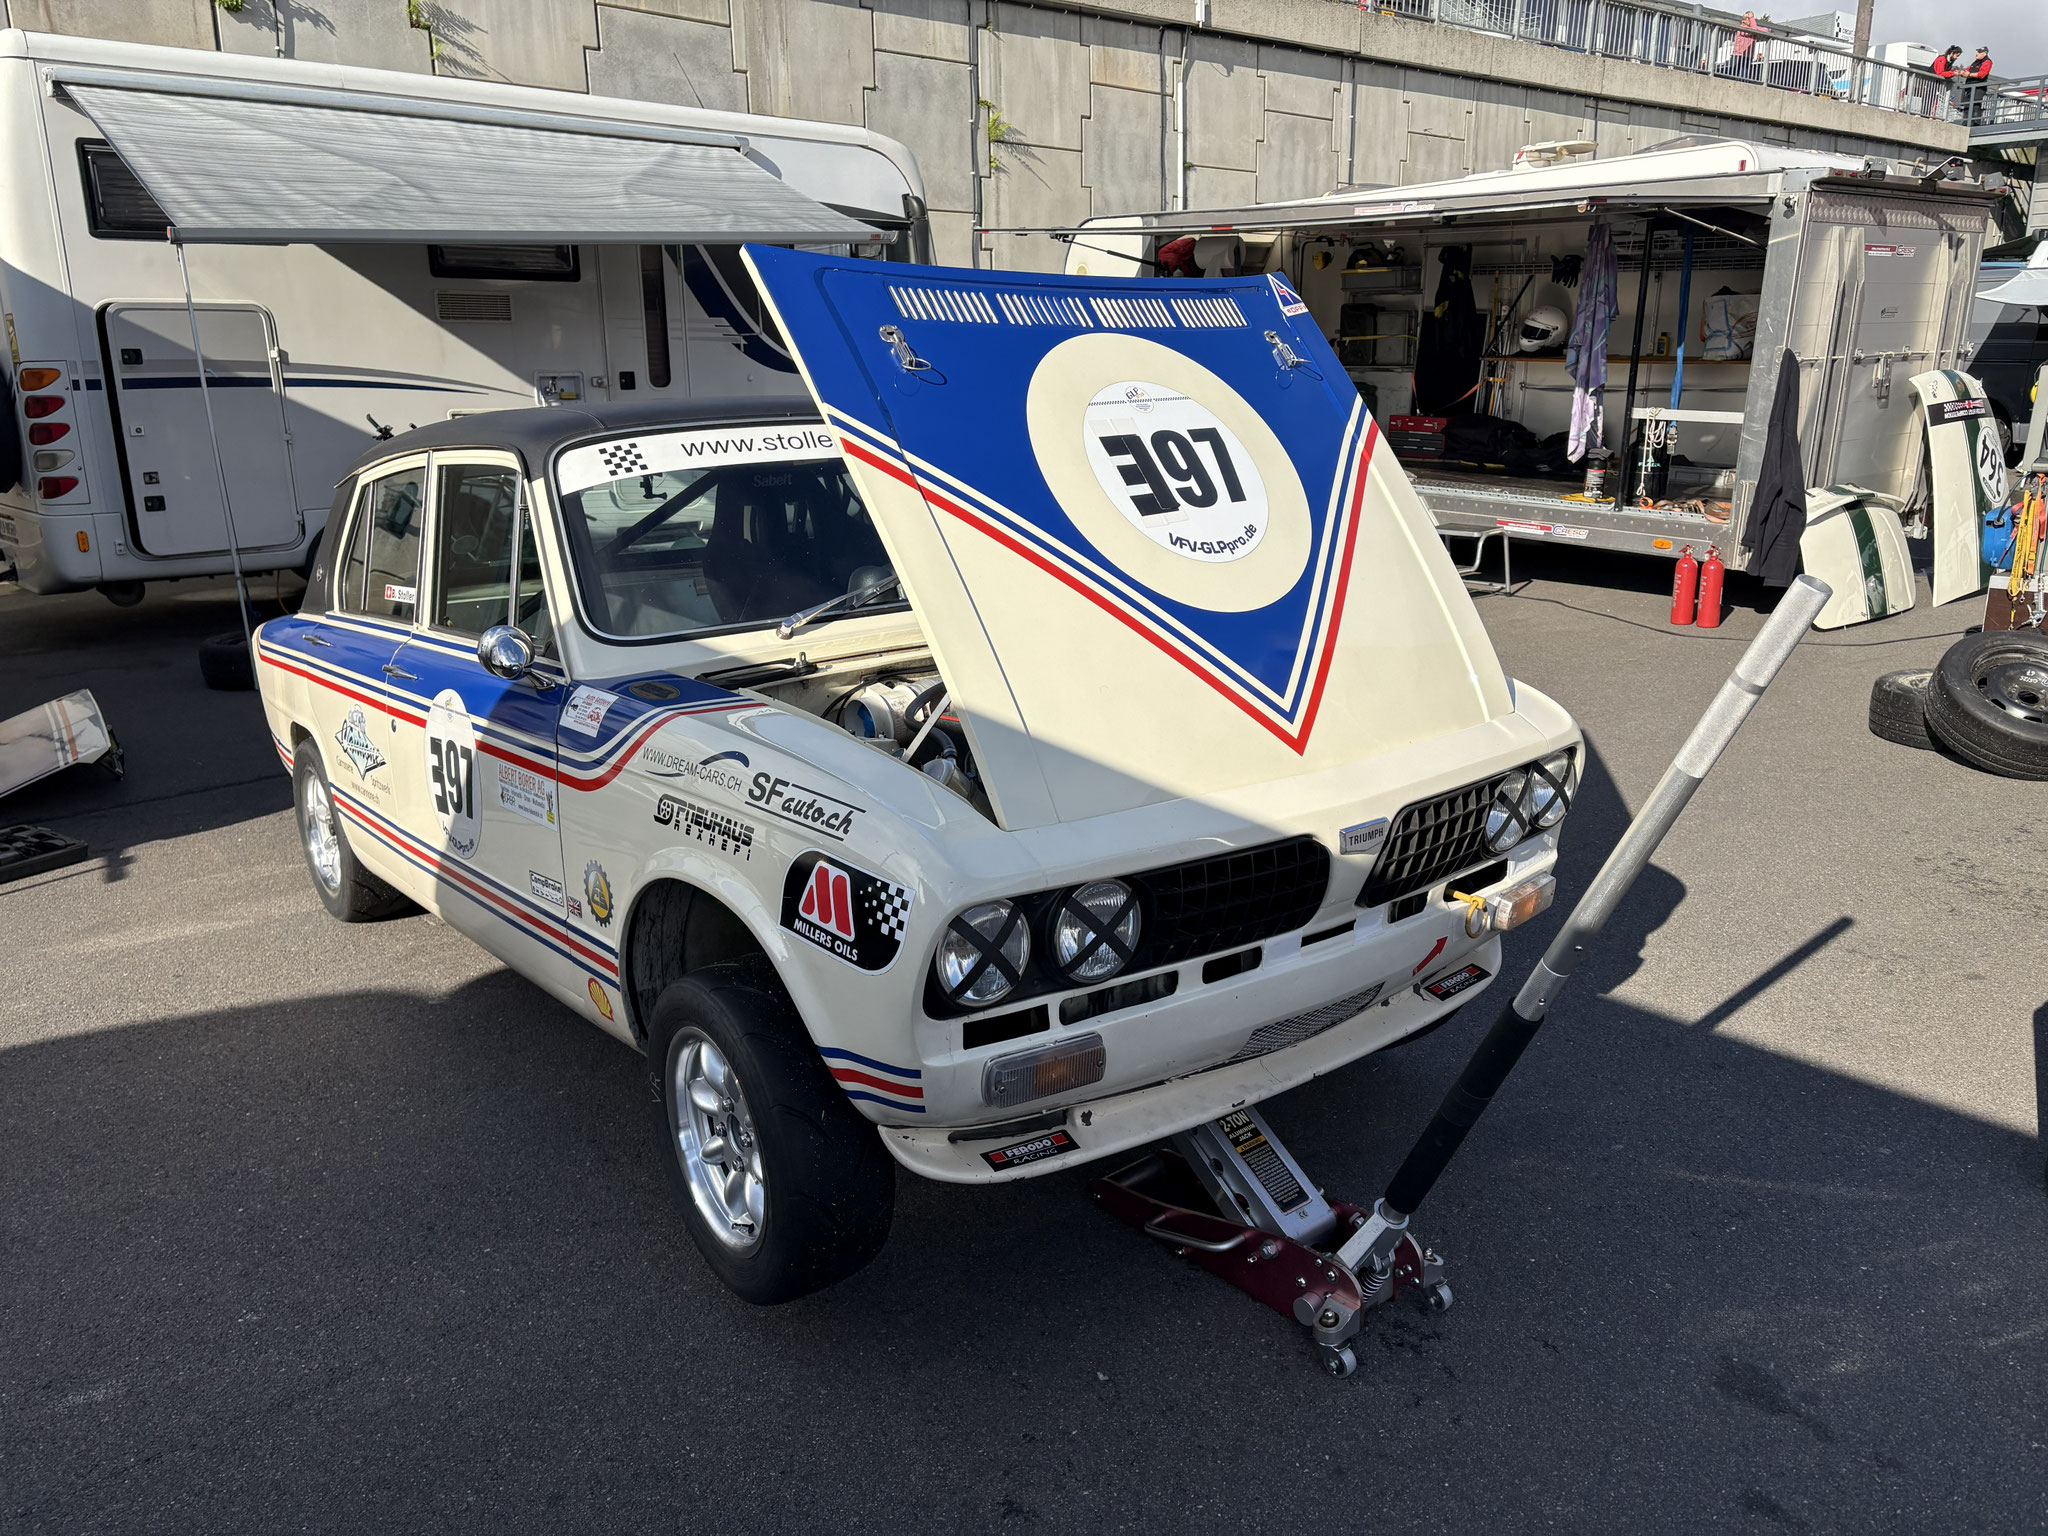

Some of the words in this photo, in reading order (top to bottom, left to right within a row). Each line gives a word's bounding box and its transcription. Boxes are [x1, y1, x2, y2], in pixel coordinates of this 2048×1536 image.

[1126, 387, 1139, 400] GLP
[1098, 427, 1247, 517] 397
[1980, 435, 2004, 498] 364
[753, 473, 793, 488] Sabelt
[1168, 523, 1257, 555] VFV-GLPpro.de
[392, 589, 397, 599] B.
[430, 736, 474, 820] 397
[642, 747, 743, 792] WWW.DREAM-CARS.CH
[499, 763, 517, 784] ALBERT
[518, 771, 537, 793] BORER
[537, 779, 545, 796] AG
[674, 819, 752, 861] REXHEPI
[1349, 827, 1384, 846] TRIUMPH
[530, 873, 562, 893] CompBrake
[793, 918, 833, 948] MILLERS
[834, 941, 859, 961] OILS
[1440, 972, 1470, 989] FERODO
[1449, 977, 1478, 993] RACING
[1229, 1123, 1256, 1140] ALUMINUM
[1239, 1132, 1253, 1142] JACK
[1005, 1139, 1052, 1158] FERODO
[1013, 1147, 1058, 1165] RACING
